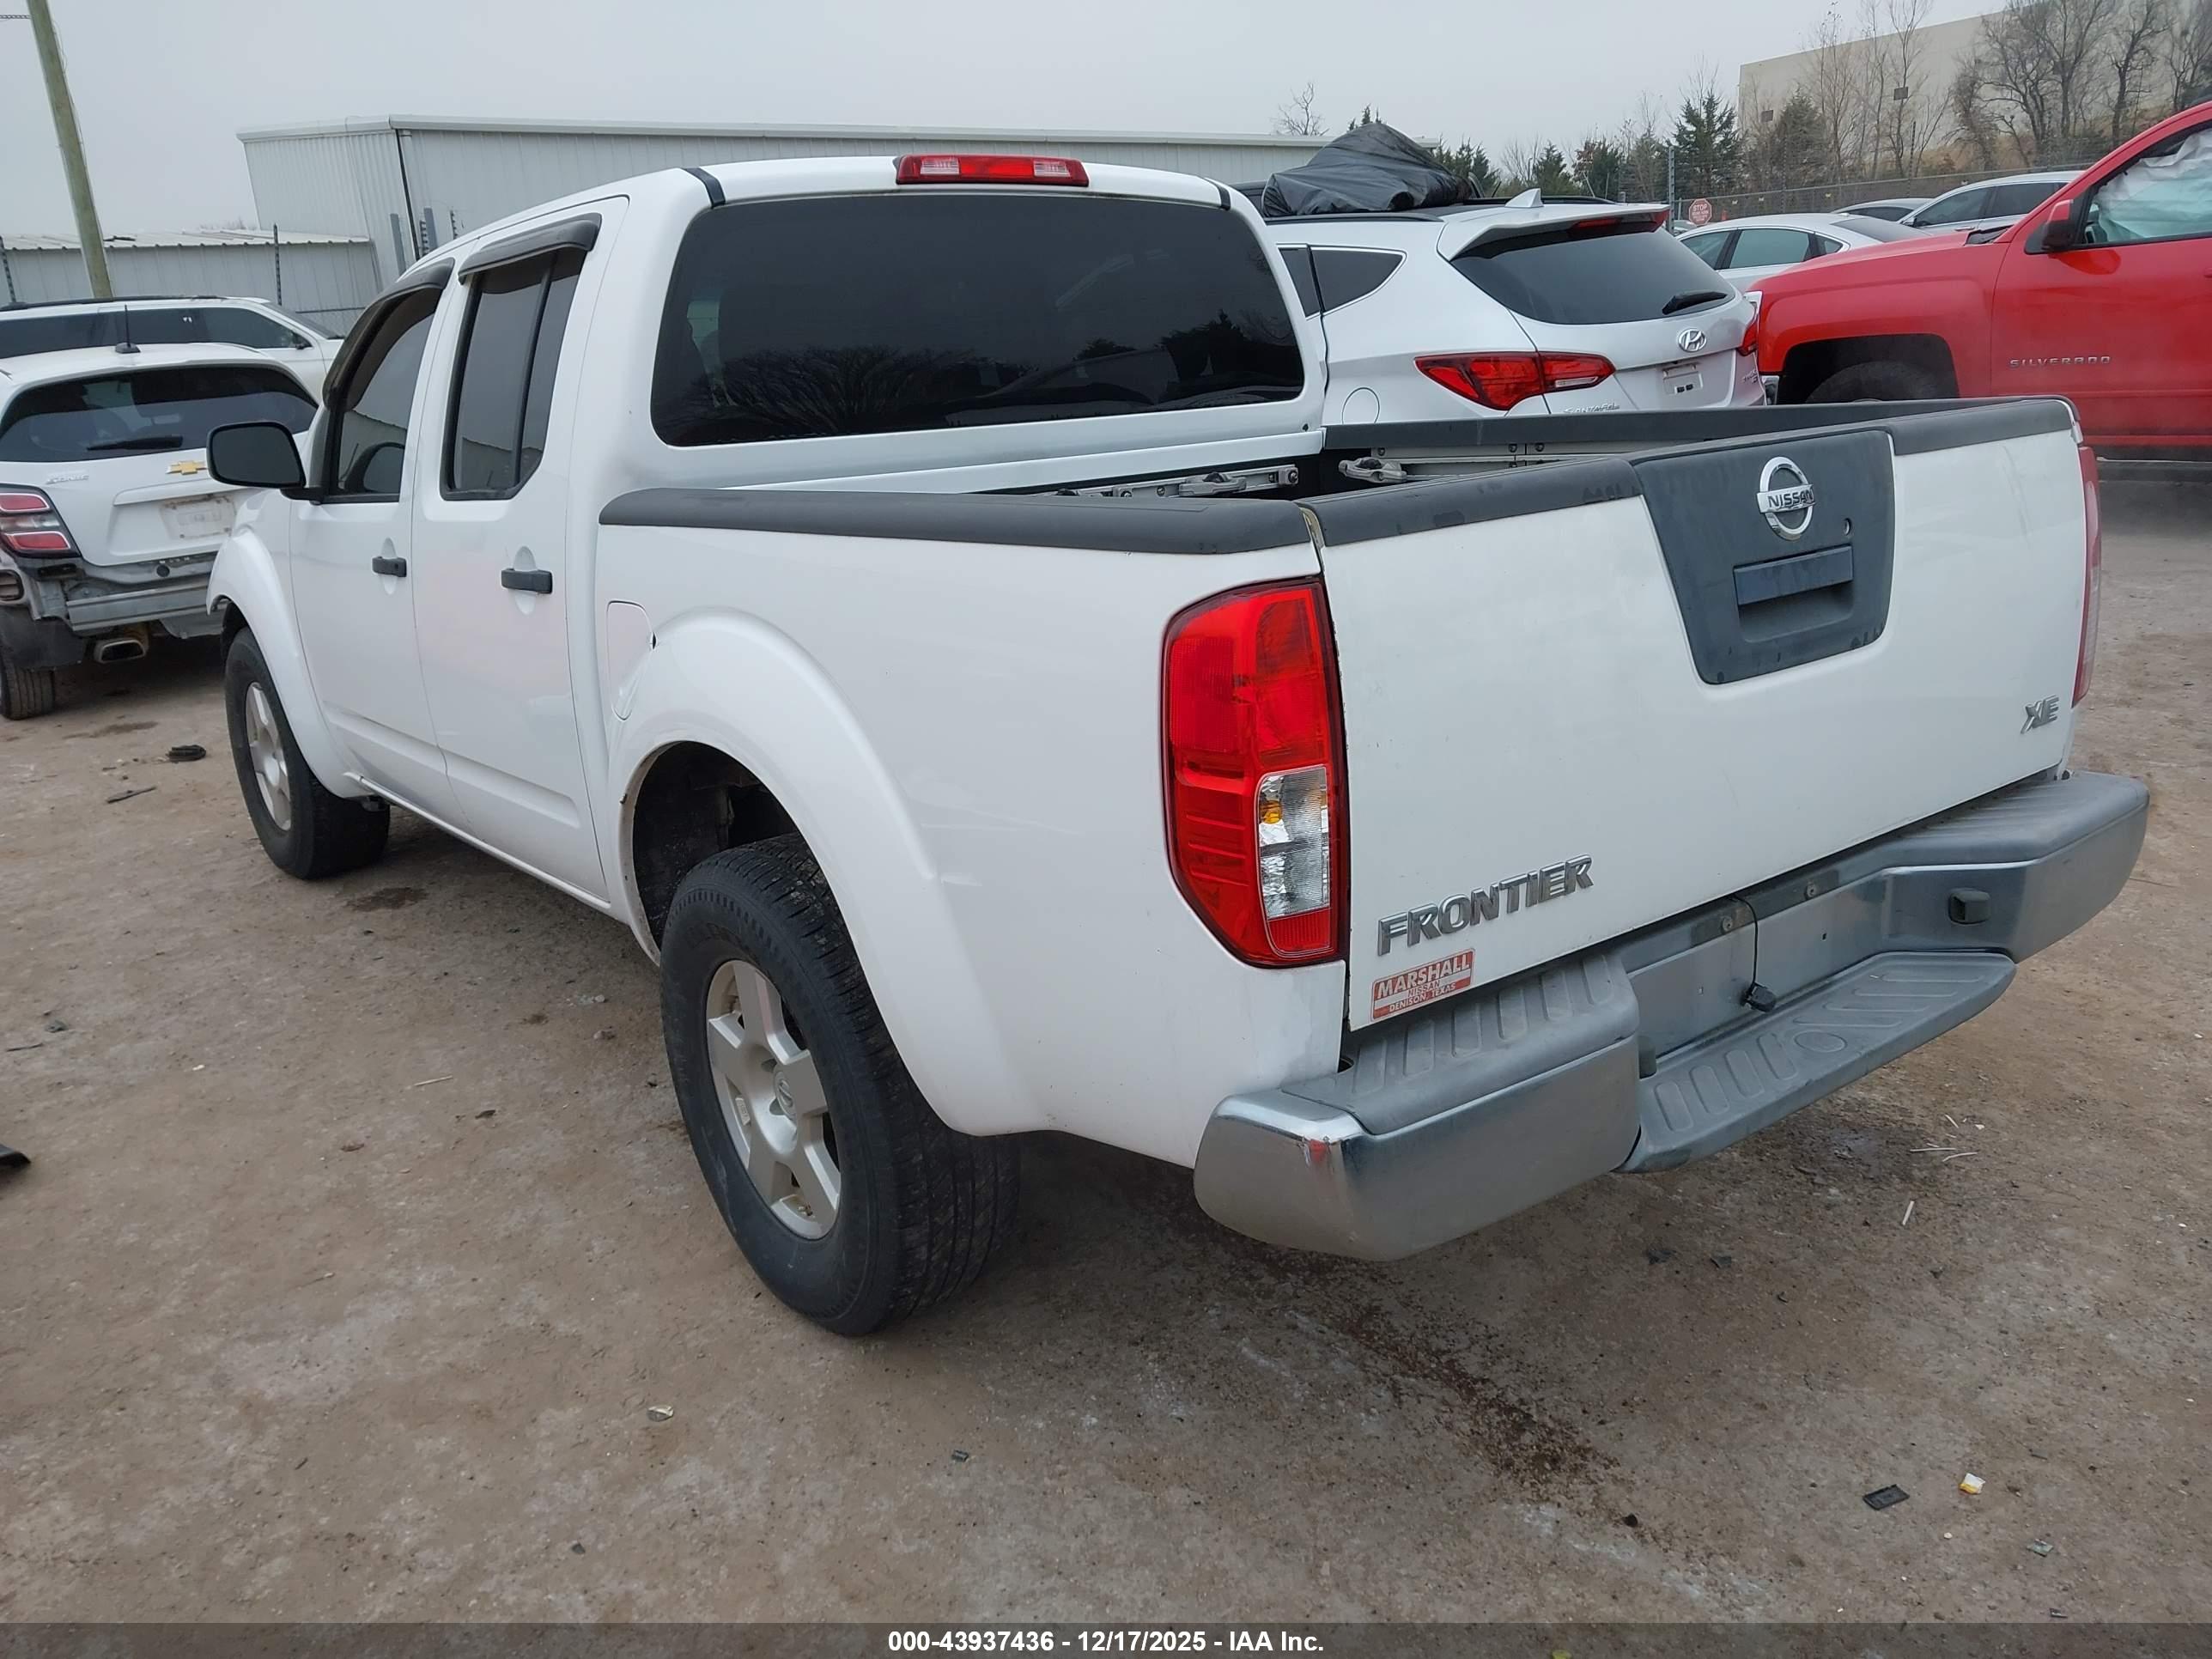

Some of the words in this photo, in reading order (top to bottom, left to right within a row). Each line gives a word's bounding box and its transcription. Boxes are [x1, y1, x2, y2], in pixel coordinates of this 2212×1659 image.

[2009, 356, 2111, 368] SILVERADO
[1767, 489, 1813, 508] NISSAN
[2020, 694, 2060, 734] XE
[1377, 854, 1594, 957] FRONTIER
[1376, 954, 1470, 1000] MARSHALL
[1407, 980, 1441, 998] NISSAN
[1431, 982, 1456, 998] TEXAS
